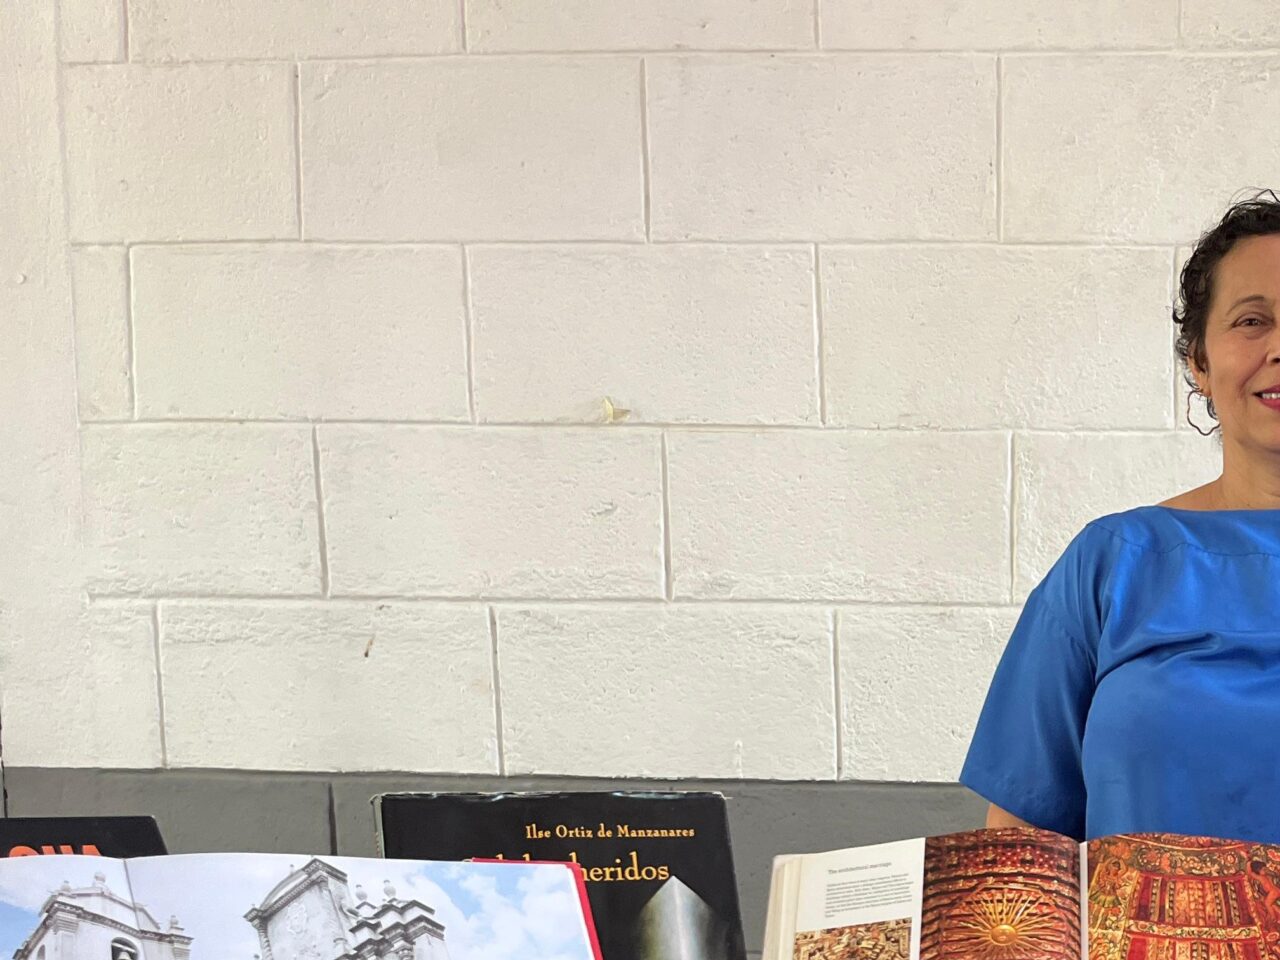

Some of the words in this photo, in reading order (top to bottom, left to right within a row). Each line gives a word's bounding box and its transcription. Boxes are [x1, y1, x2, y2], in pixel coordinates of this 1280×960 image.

[525, 823, 551, 839] Ilse
[555, 824, 593, 838] Ortiz
[597, 823, 613, 838] de
[617, 824, 695, 838] Manzanares
